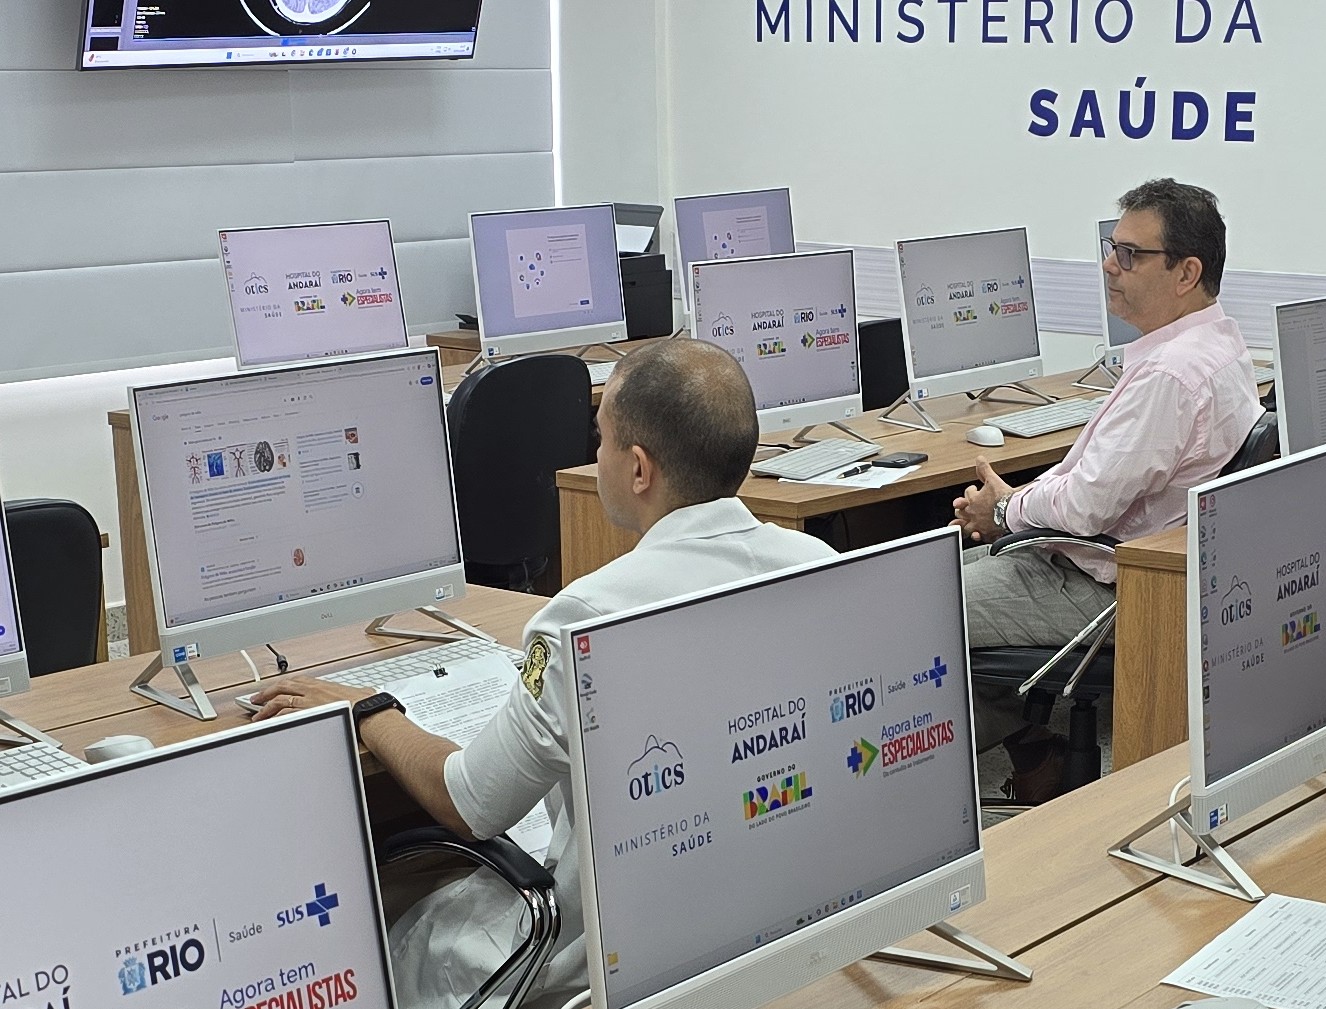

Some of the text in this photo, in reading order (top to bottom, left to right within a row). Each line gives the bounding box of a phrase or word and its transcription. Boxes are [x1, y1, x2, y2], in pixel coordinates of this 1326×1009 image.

[1175, 0, 1262, 43] DA
[1028, 76, 1256, 142] SAÚDE
[752, 316, 784, 332] ANDARAÍ
[800, 311, 814, 322] RIO
[1276, 552, 1320, 579] HOSPITAL DO
[1277, 564, 1320, 602] ANDARAÍ
[1221, 599, 1252, 626] otics
[1211, 641, 1252, 667] MINISTÉRIO
[1241, 653, 1265, 671] SAÚDE
[829, 677, 874, 696] PREFEITURA
[888, 681, 906, 694] Saúde
[913, 670, 929, 686] SUS
[728, 697, 806, 735] HOSPITAL DO
[845, 687, 876, 718] RIO
[731, 711, 807, 764] ANDARAÍ
[881, 711, 933, 741] Agora tem
[881, 719, 955, 767] ESPECIALISTAS
[629, 762, 685, 801] otics
[756, 763, 796, 783] GOVERNO DO
[742, 771, 813, 821] BRASIL
[614, 811, 710, 857] MINISTÉRIO DA
[672, 830, 713, 857] SAÚDE
[277, 905, 304, 929] SUS
[115, 923, 200, 958] PREFEITURA
[229, 922, 263, 943] Saúde
[147, 937, 206, 986] RIO
[0, 977, 30, 1004] AL
[35, 964, 69, 992] DO
[220, 962, 316, 1009] Agora tem
